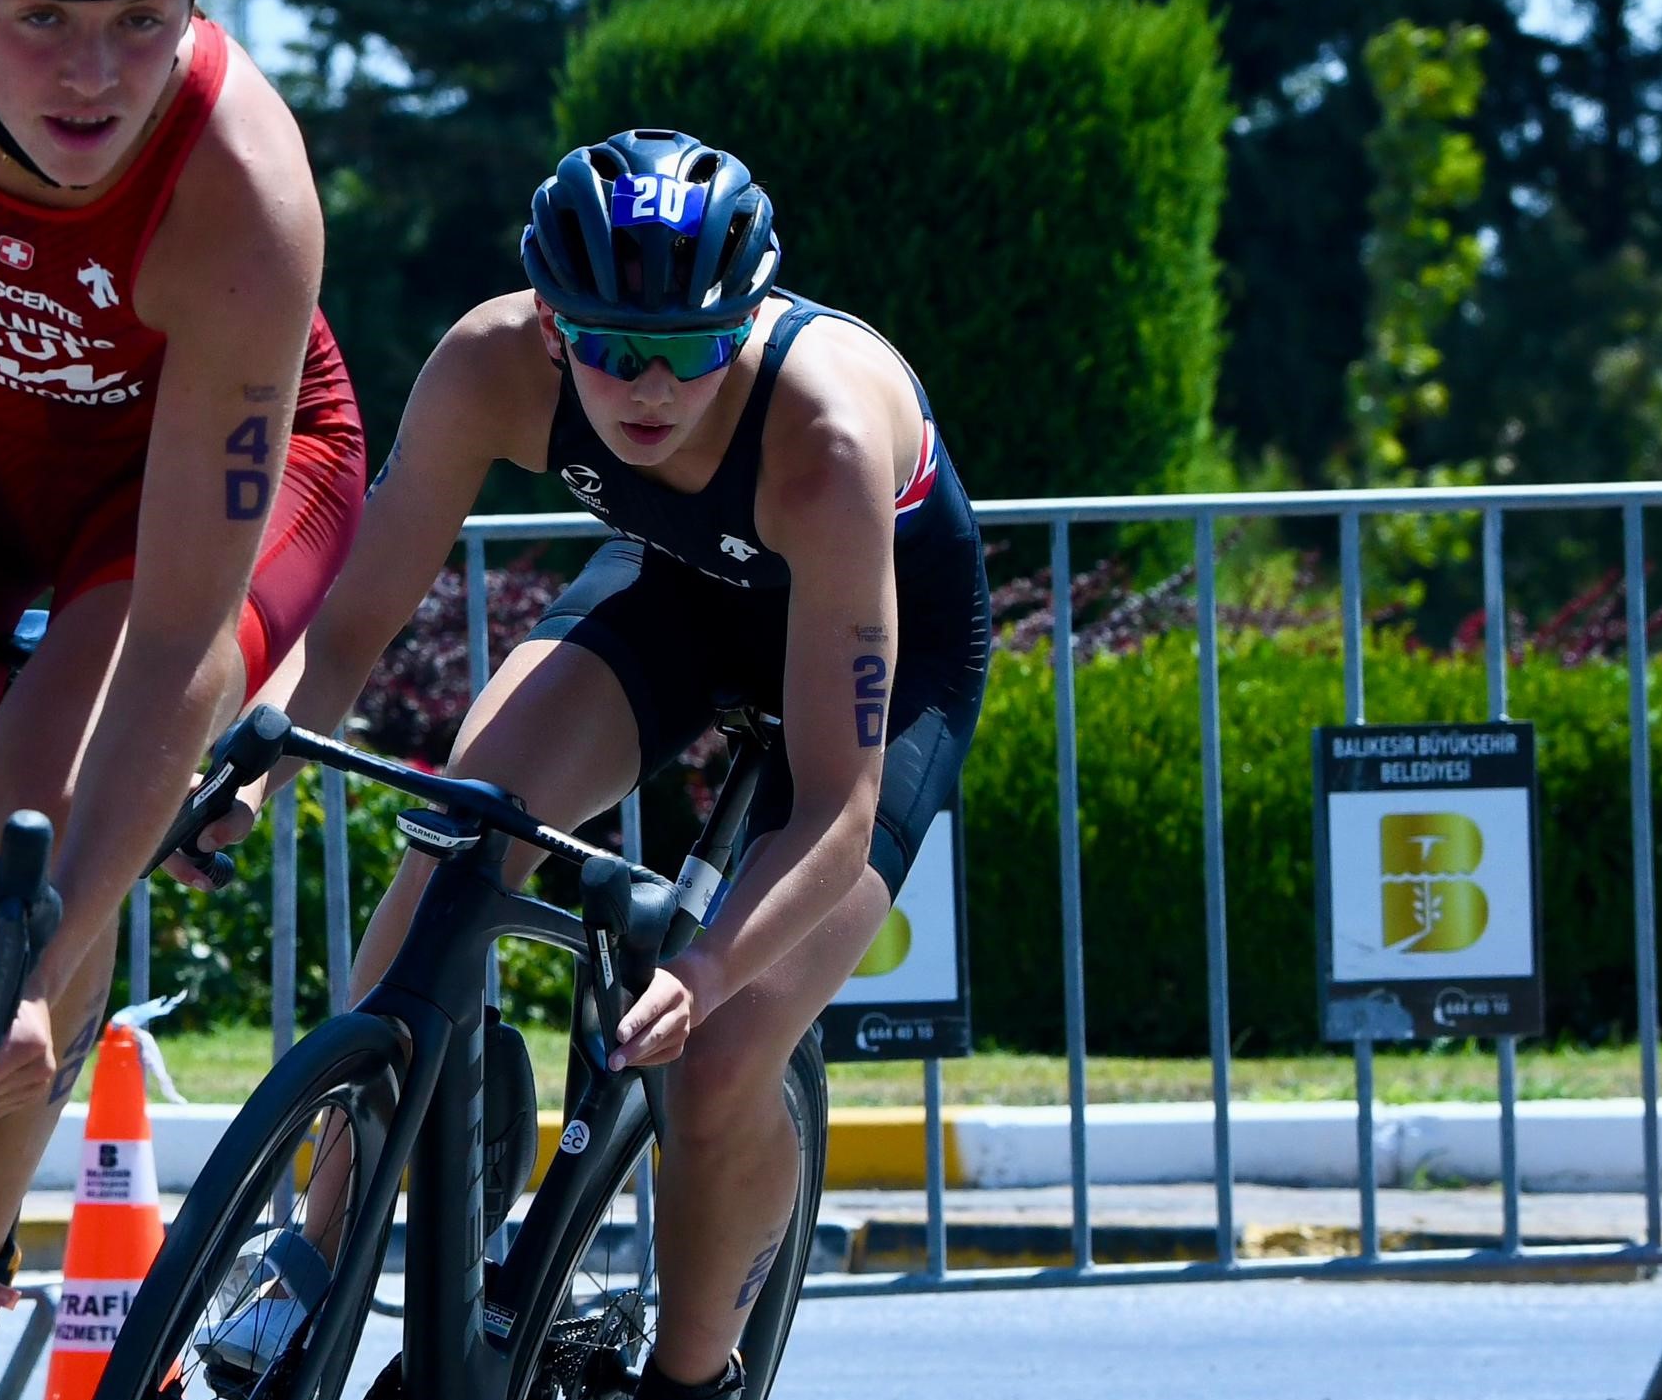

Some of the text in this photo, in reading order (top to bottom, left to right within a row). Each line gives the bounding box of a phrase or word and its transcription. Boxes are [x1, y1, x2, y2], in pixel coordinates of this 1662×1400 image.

[632, 176, 688, 223] 2D
[226, 415, 270, 520] 4D
[853, 655, 887, 748] 2D
[405, 823, 440, 842] GARMIN
[62, 1290, 136, 1317] TRAFİ
